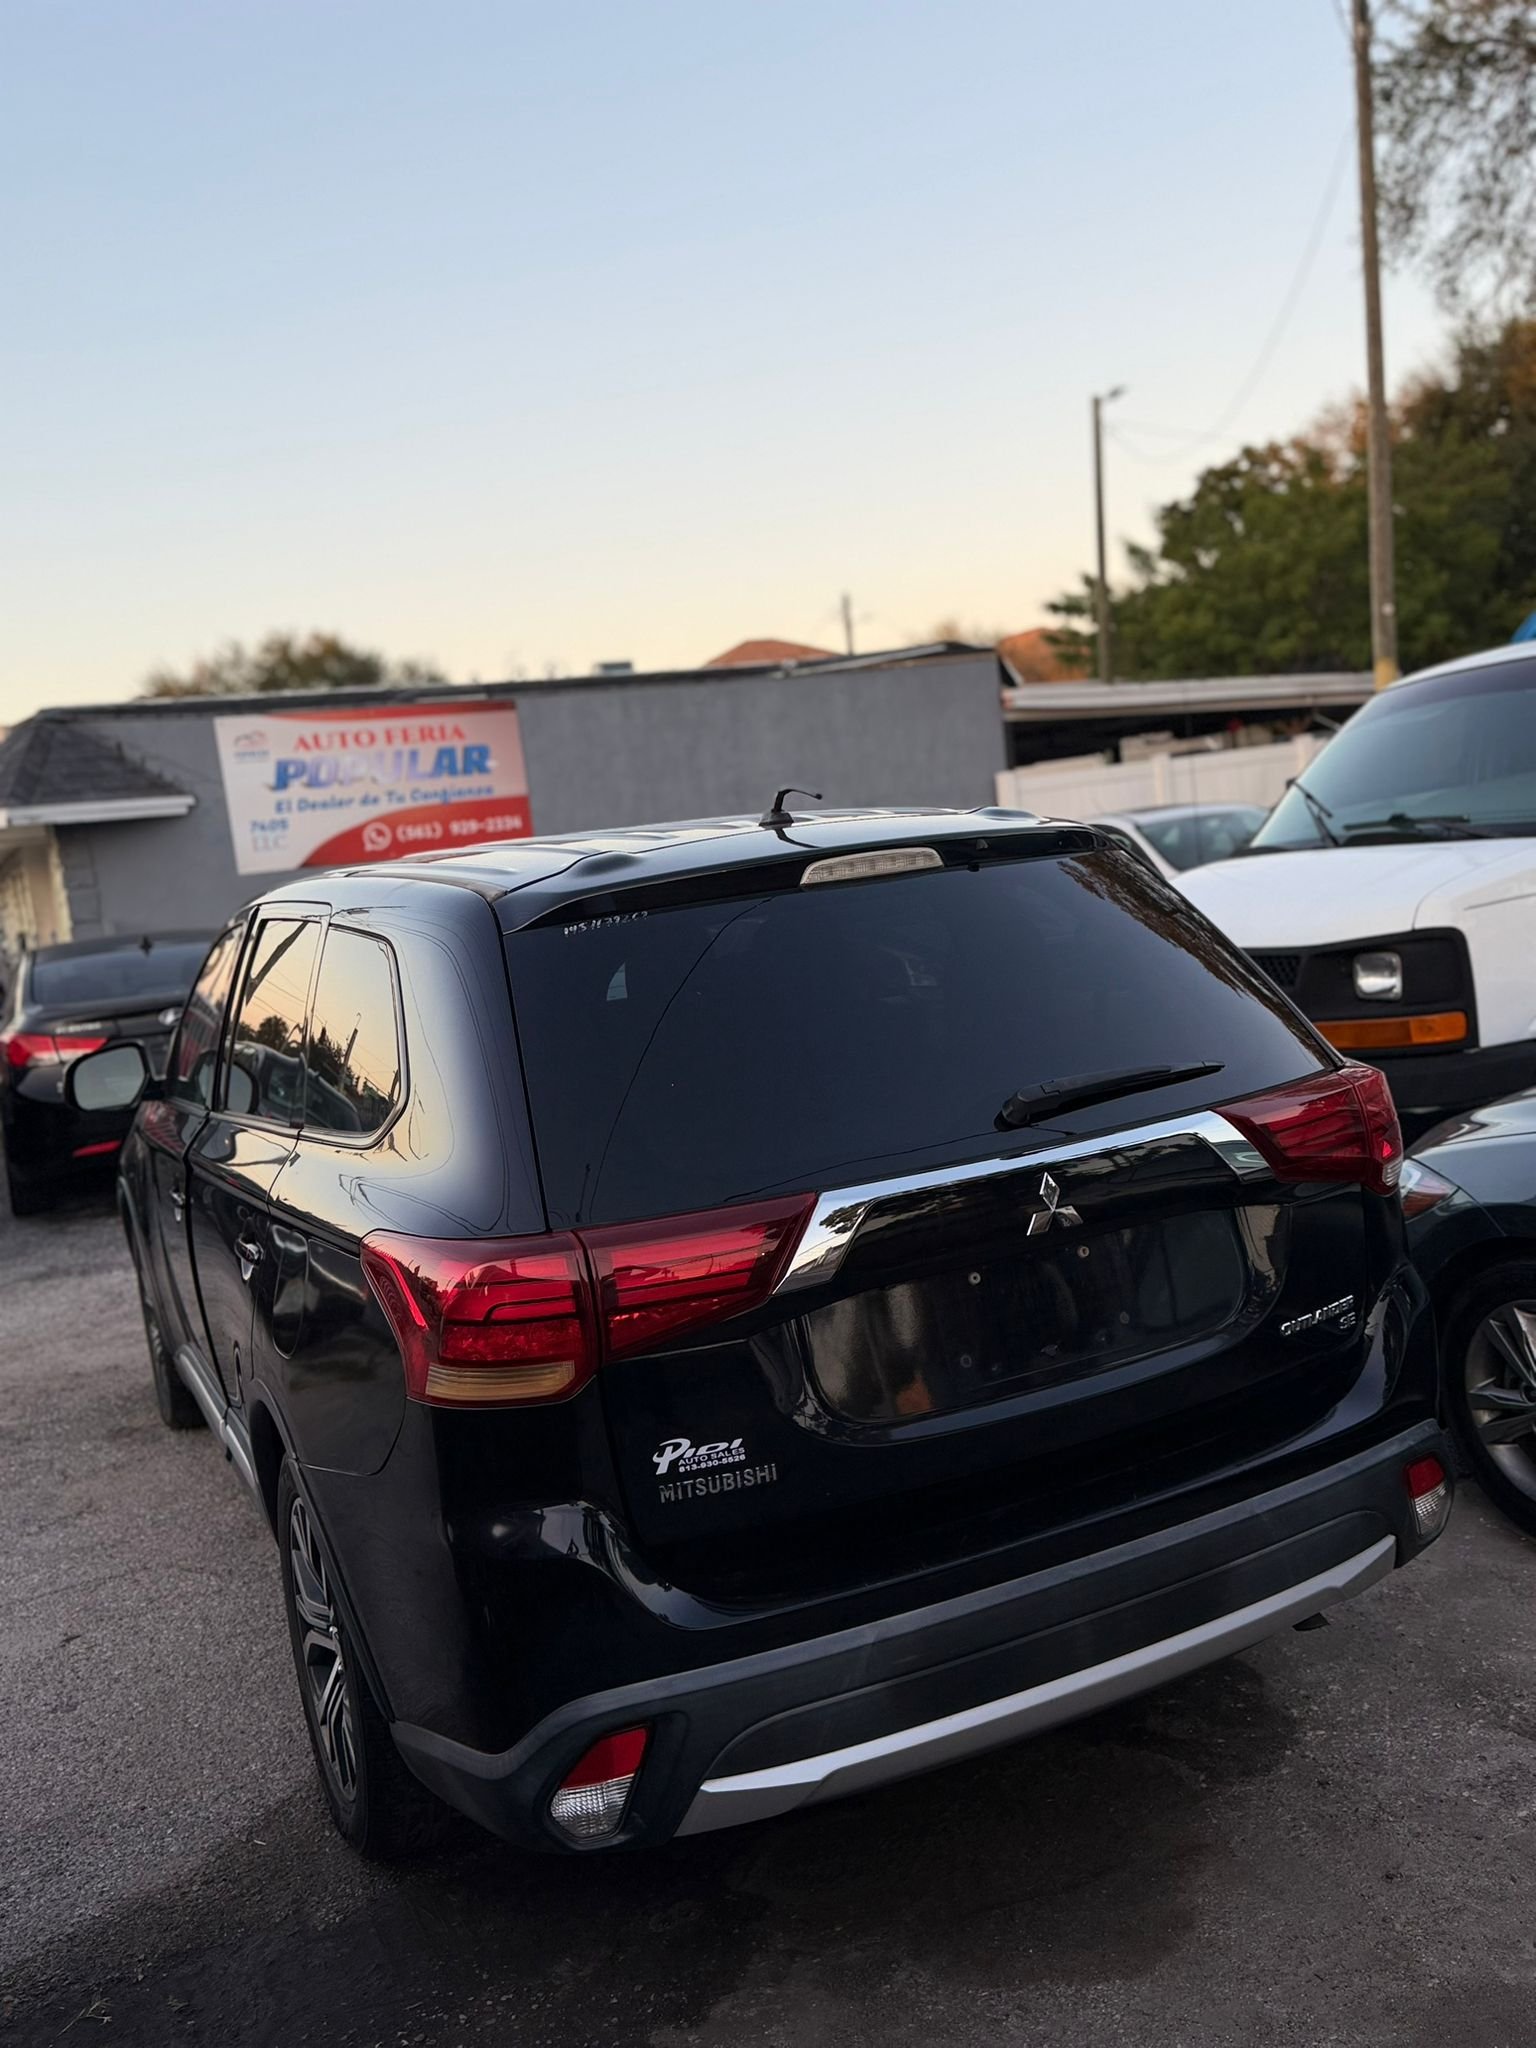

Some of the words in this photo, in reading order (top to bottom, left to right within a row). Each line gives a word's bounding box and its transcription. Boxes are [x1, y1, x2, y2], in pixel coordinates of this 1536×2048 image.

[293, 729, 376, 752] AUTO
[384, 723, 466, 746] FERIA
[270, 743, 493, 791] POPULAR
[275, 799, 291, 813] El
[297, 795, 354, 812] Dealer
[359, 791, 380, 806] de
[384, 789, 406, 804] Tu
[1339, 1311, 1357, 1329] SE
[678, 1454, 709, 1466] AUTO
[710, 1447, 746, 1459] SALES
[658, 1463, 778, 1504] MITSUBISHI
